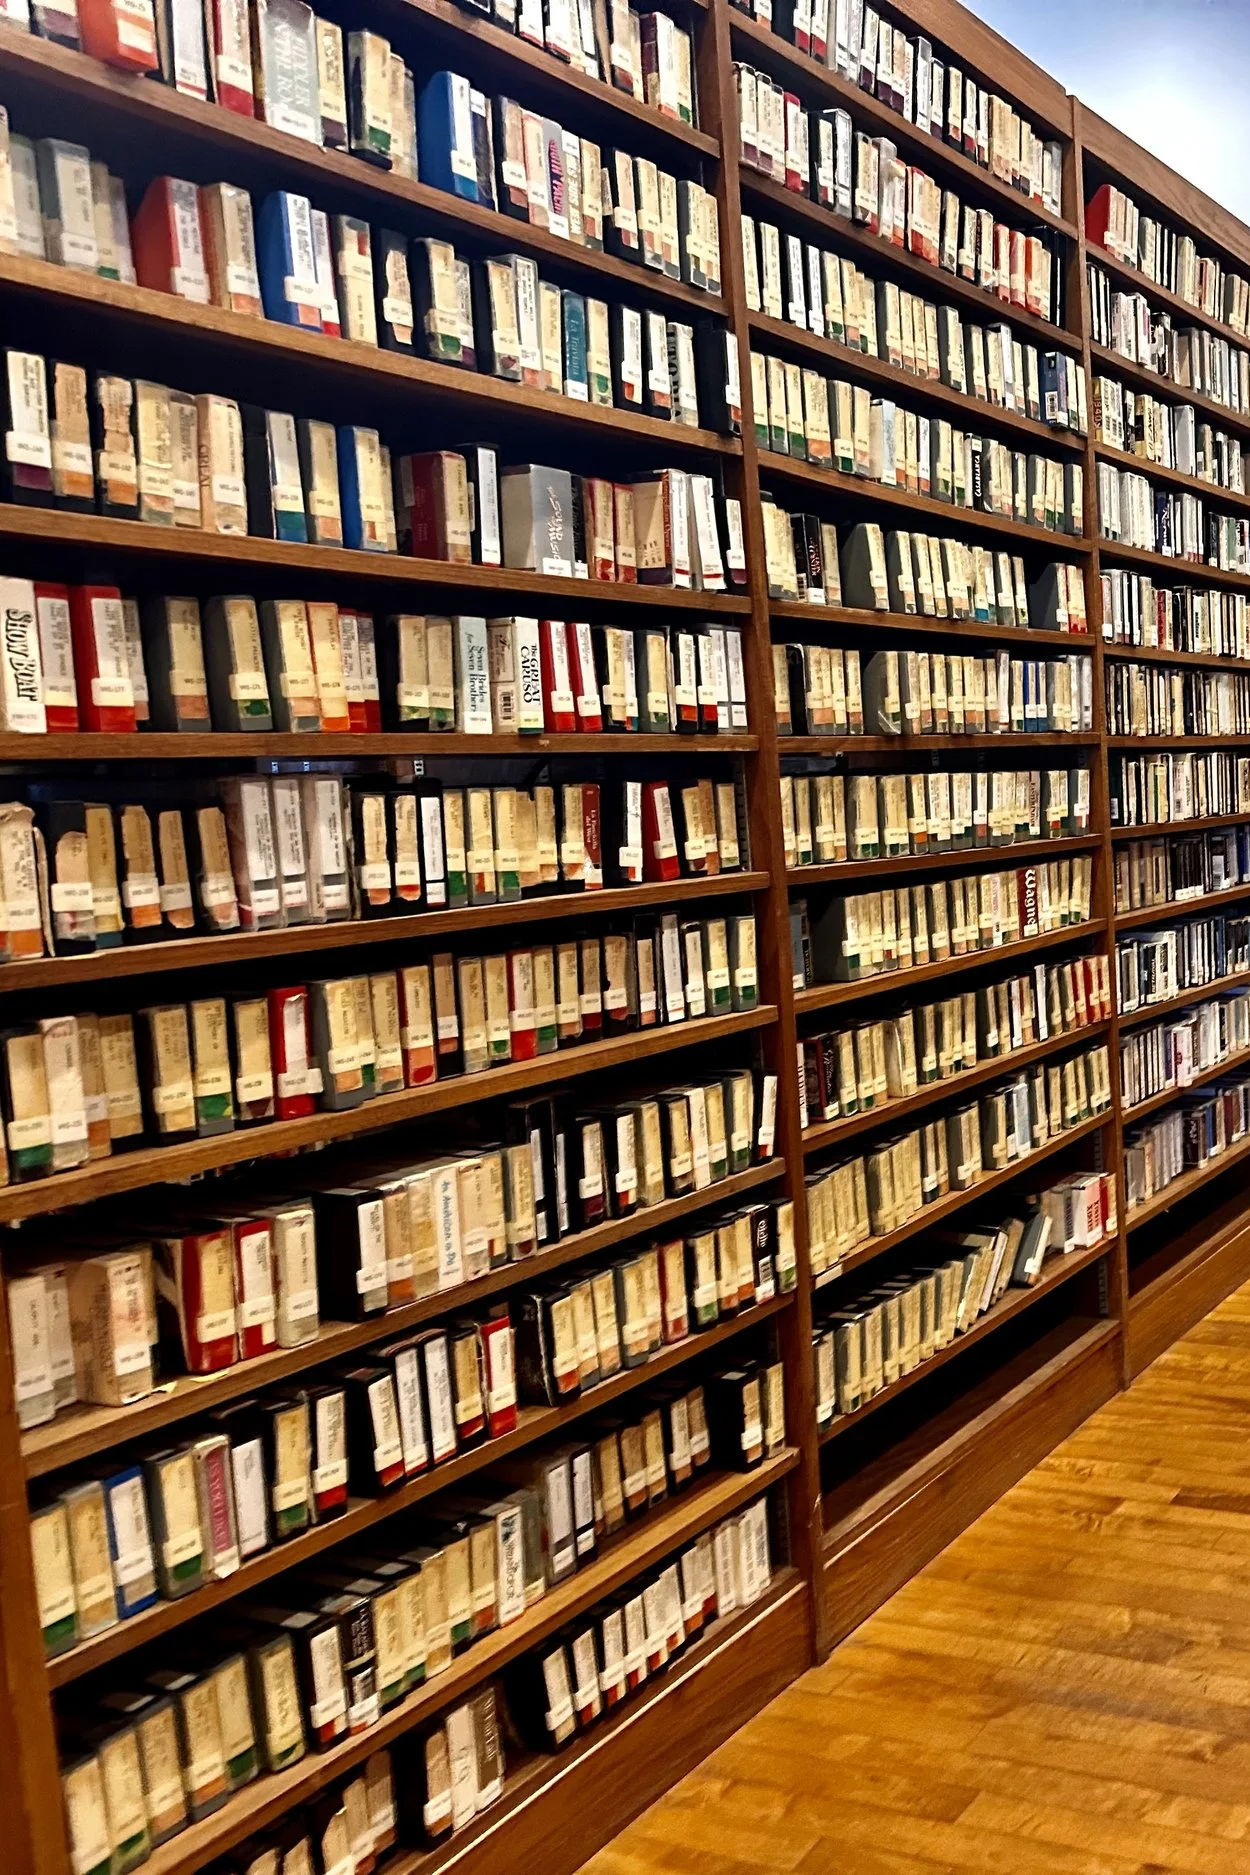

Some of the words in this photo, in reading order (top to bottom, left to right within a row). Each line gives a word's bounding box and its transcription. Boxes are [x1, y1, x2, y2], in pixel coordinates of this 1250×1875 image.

[570, 337, 579, 376] Traviata
[551, 498, 562, 540] SOUND
[7, 609, 31, 655] SHOW
[11, 653, 37, 701] BOAT
[467, 645, 476, 672] Seven
[476, 646, 485, 673] Seven
[520, 645, 533, 703] CARUSO
[469, 673, 478, 712] Brothers
[477, 673, 485, 703] Brides
[530, 657, 542, 702] GREAT
